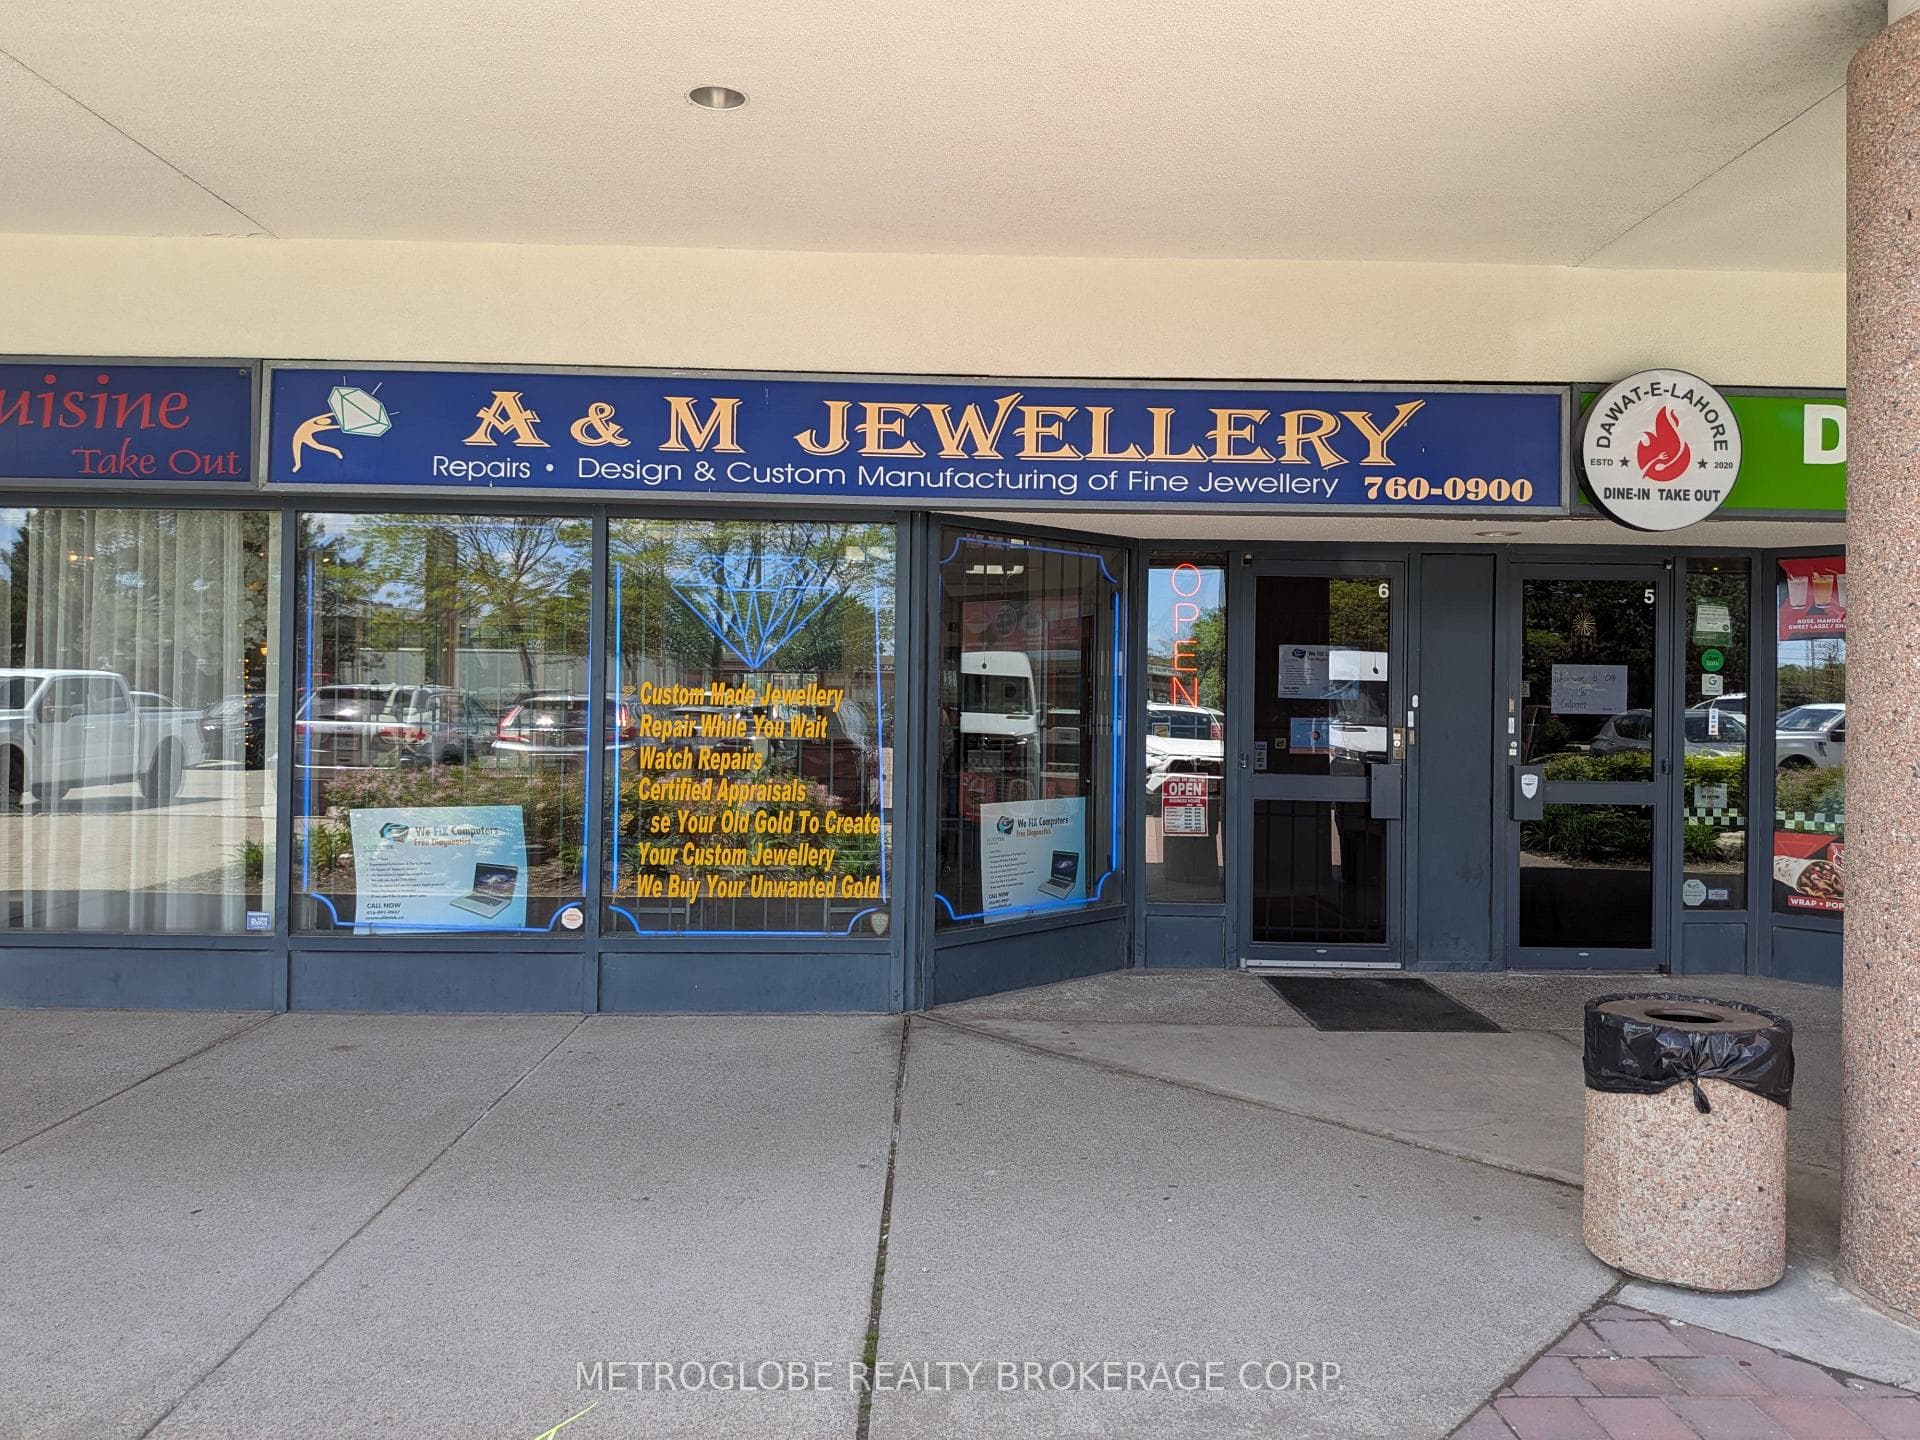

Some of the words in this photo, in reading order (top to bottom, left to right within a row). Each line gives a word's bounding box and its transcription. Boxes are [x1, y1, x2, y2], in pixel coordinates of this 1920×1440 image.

[461, 389, 552, 449] A
[570, 400, 632, 448] &
[658, 395, 748, 454] M
[793, 391, 1427, 472] JEWELLERY
[1596, 381, 1729, 452] DAWAT-E-LAHORE
[72, 436, 157, 478] Take
[168, 447, 243, 476] Out
[1590, 458, 1614, 467] ESTD
[1713, 461, 1734, 470] 2020
[433, 455, 532, 482] Repairs
[577, 456, 683, 487] Design
[694, 460, 717, 483] &
[727, 461, 846, 486] Custom
[858, 464, 1079, 496] Manufacturing
[1088, 468, 1119, 493] of
[1129, 470, 1189, 494] Fine
[1198, 470, 1340, 498] Jewellery
[1364, 475, 1533, 503] 760-0900
[1603, 486, 1651, 501] DINE-IN
[1657, 488, 1691, 502] TAKE
[1694, 489, 1721, 502] OUT
[1378, 583, 1390, 599] 6
[1643, 588, 1655, 604] 5
[1171, 563, 1202, 708] OPEN
[640, 681, 705, 706] Custom
[710, 681, 756, 706] Made
[760, 682, 844, 712] Jewellery
[639, 714, 697, 743] Repair
[701, 714, 747, 738] While
[753, 714, 785, 738] You
[789, 714, 828, 738] Wait
[639, 745, 693, 770] Watch
[698, 746, 763, 774] Repairs
[638, 777, 712, 801] Certified
[717, 778, 807, 806] Appraisals
[1169, 782, 1202, 796] OPEN
[415, 826, 431, 837] We
[451, 825, 499, 838] Computers
[677, 809, 716, 833] Your
[721, 810, 750, 833] Old
[754, 809, 793, 834] Gold
[799, 810, 819, 834] To
[825, 810, 881, 834] Create
[1017, 818, 1027, 828] We
[1039, 816, 1070, 828] Computers
[431, 837, 472, 848] Diagnostics
[638, 841, 678, 866] Your
[682, 842, 748, 866] Custom
[752, 842, 836, 872] Jewellery
[636, 874, 662, 898] We
[667, 874, 701, 904] Buy
[706, 875, 746, 898] Your
[751, 874, 837, 898] Unwanted
[841, 875, 880, 899] Gold
[1790, 897, 1817, 907] WRAP
